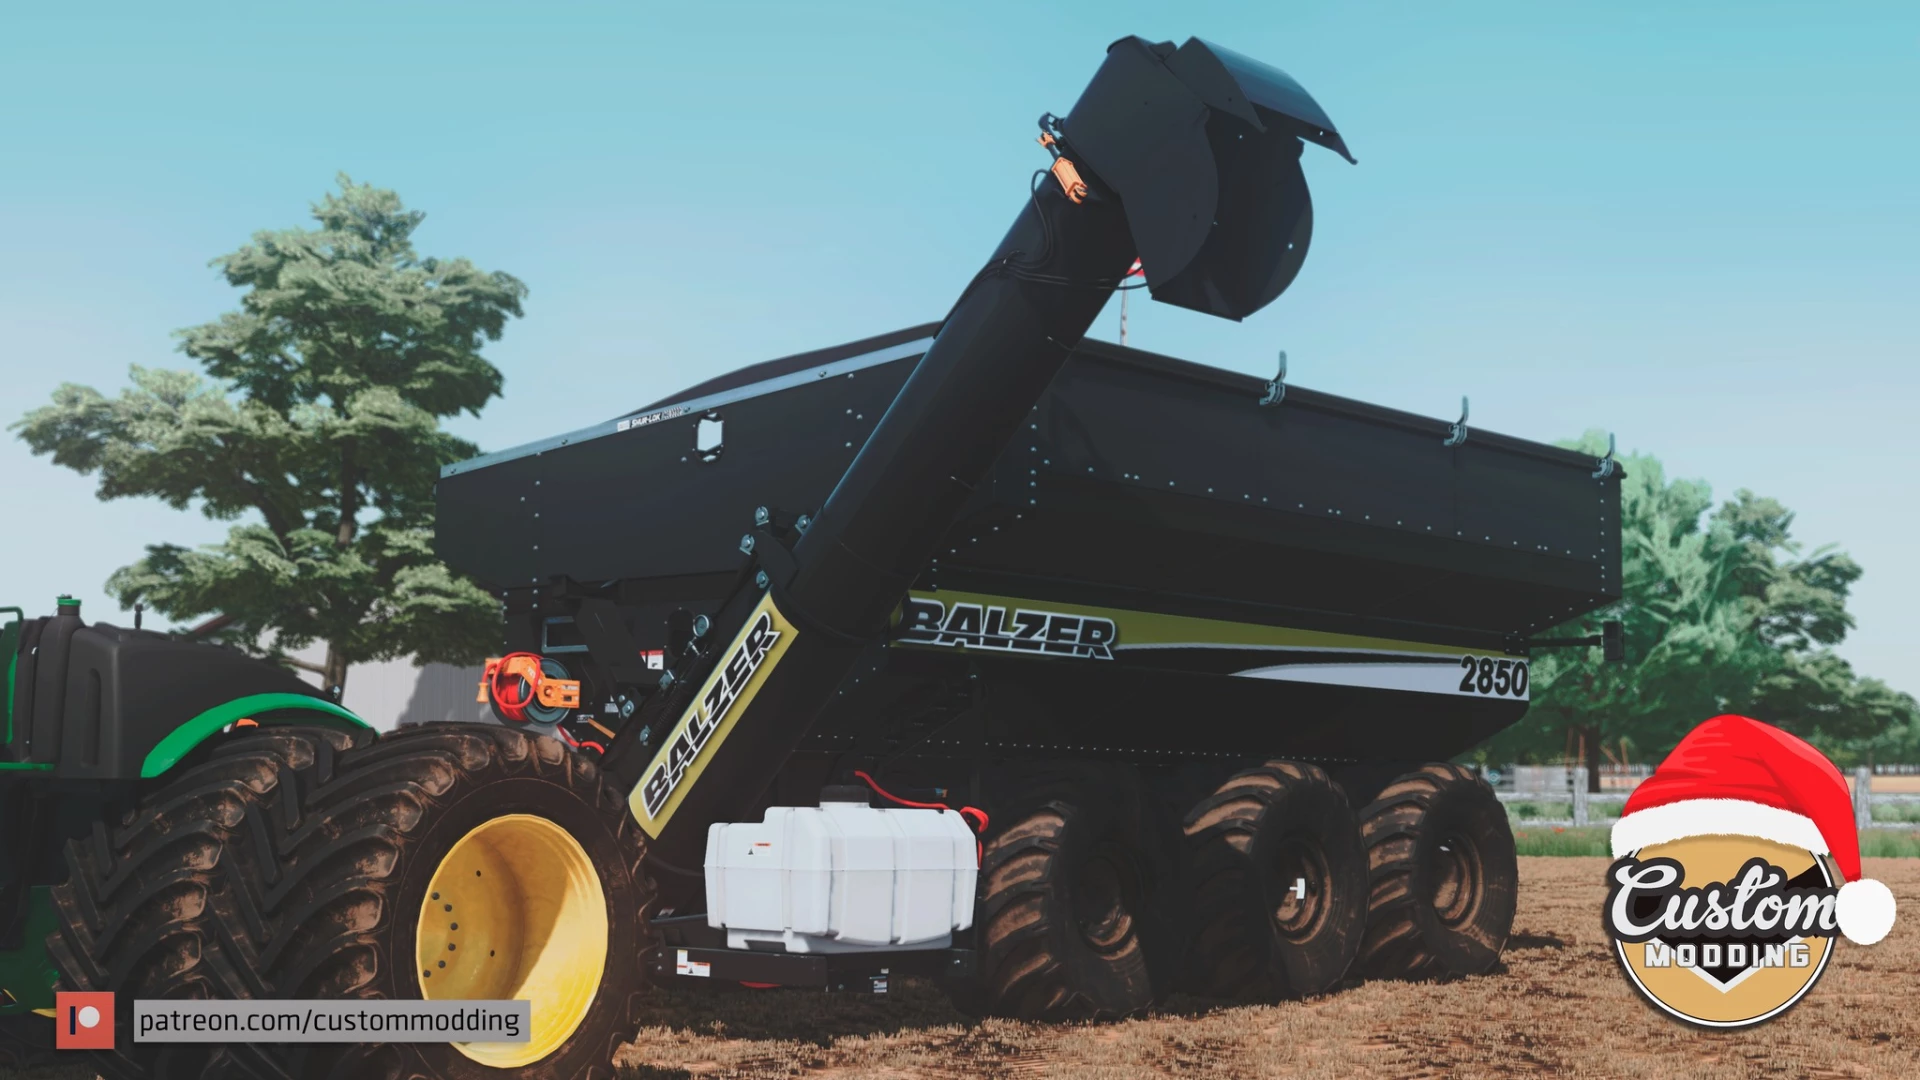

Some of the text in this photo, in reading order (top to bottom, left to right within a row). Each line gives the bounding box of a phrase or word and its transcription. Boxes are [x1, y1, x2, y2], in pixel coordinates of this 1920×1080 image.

[897, 597, 1115, 660] BALZER
[1459, 655, 1528, 697] 2850
[642, 611, 781, 820] BALZER
